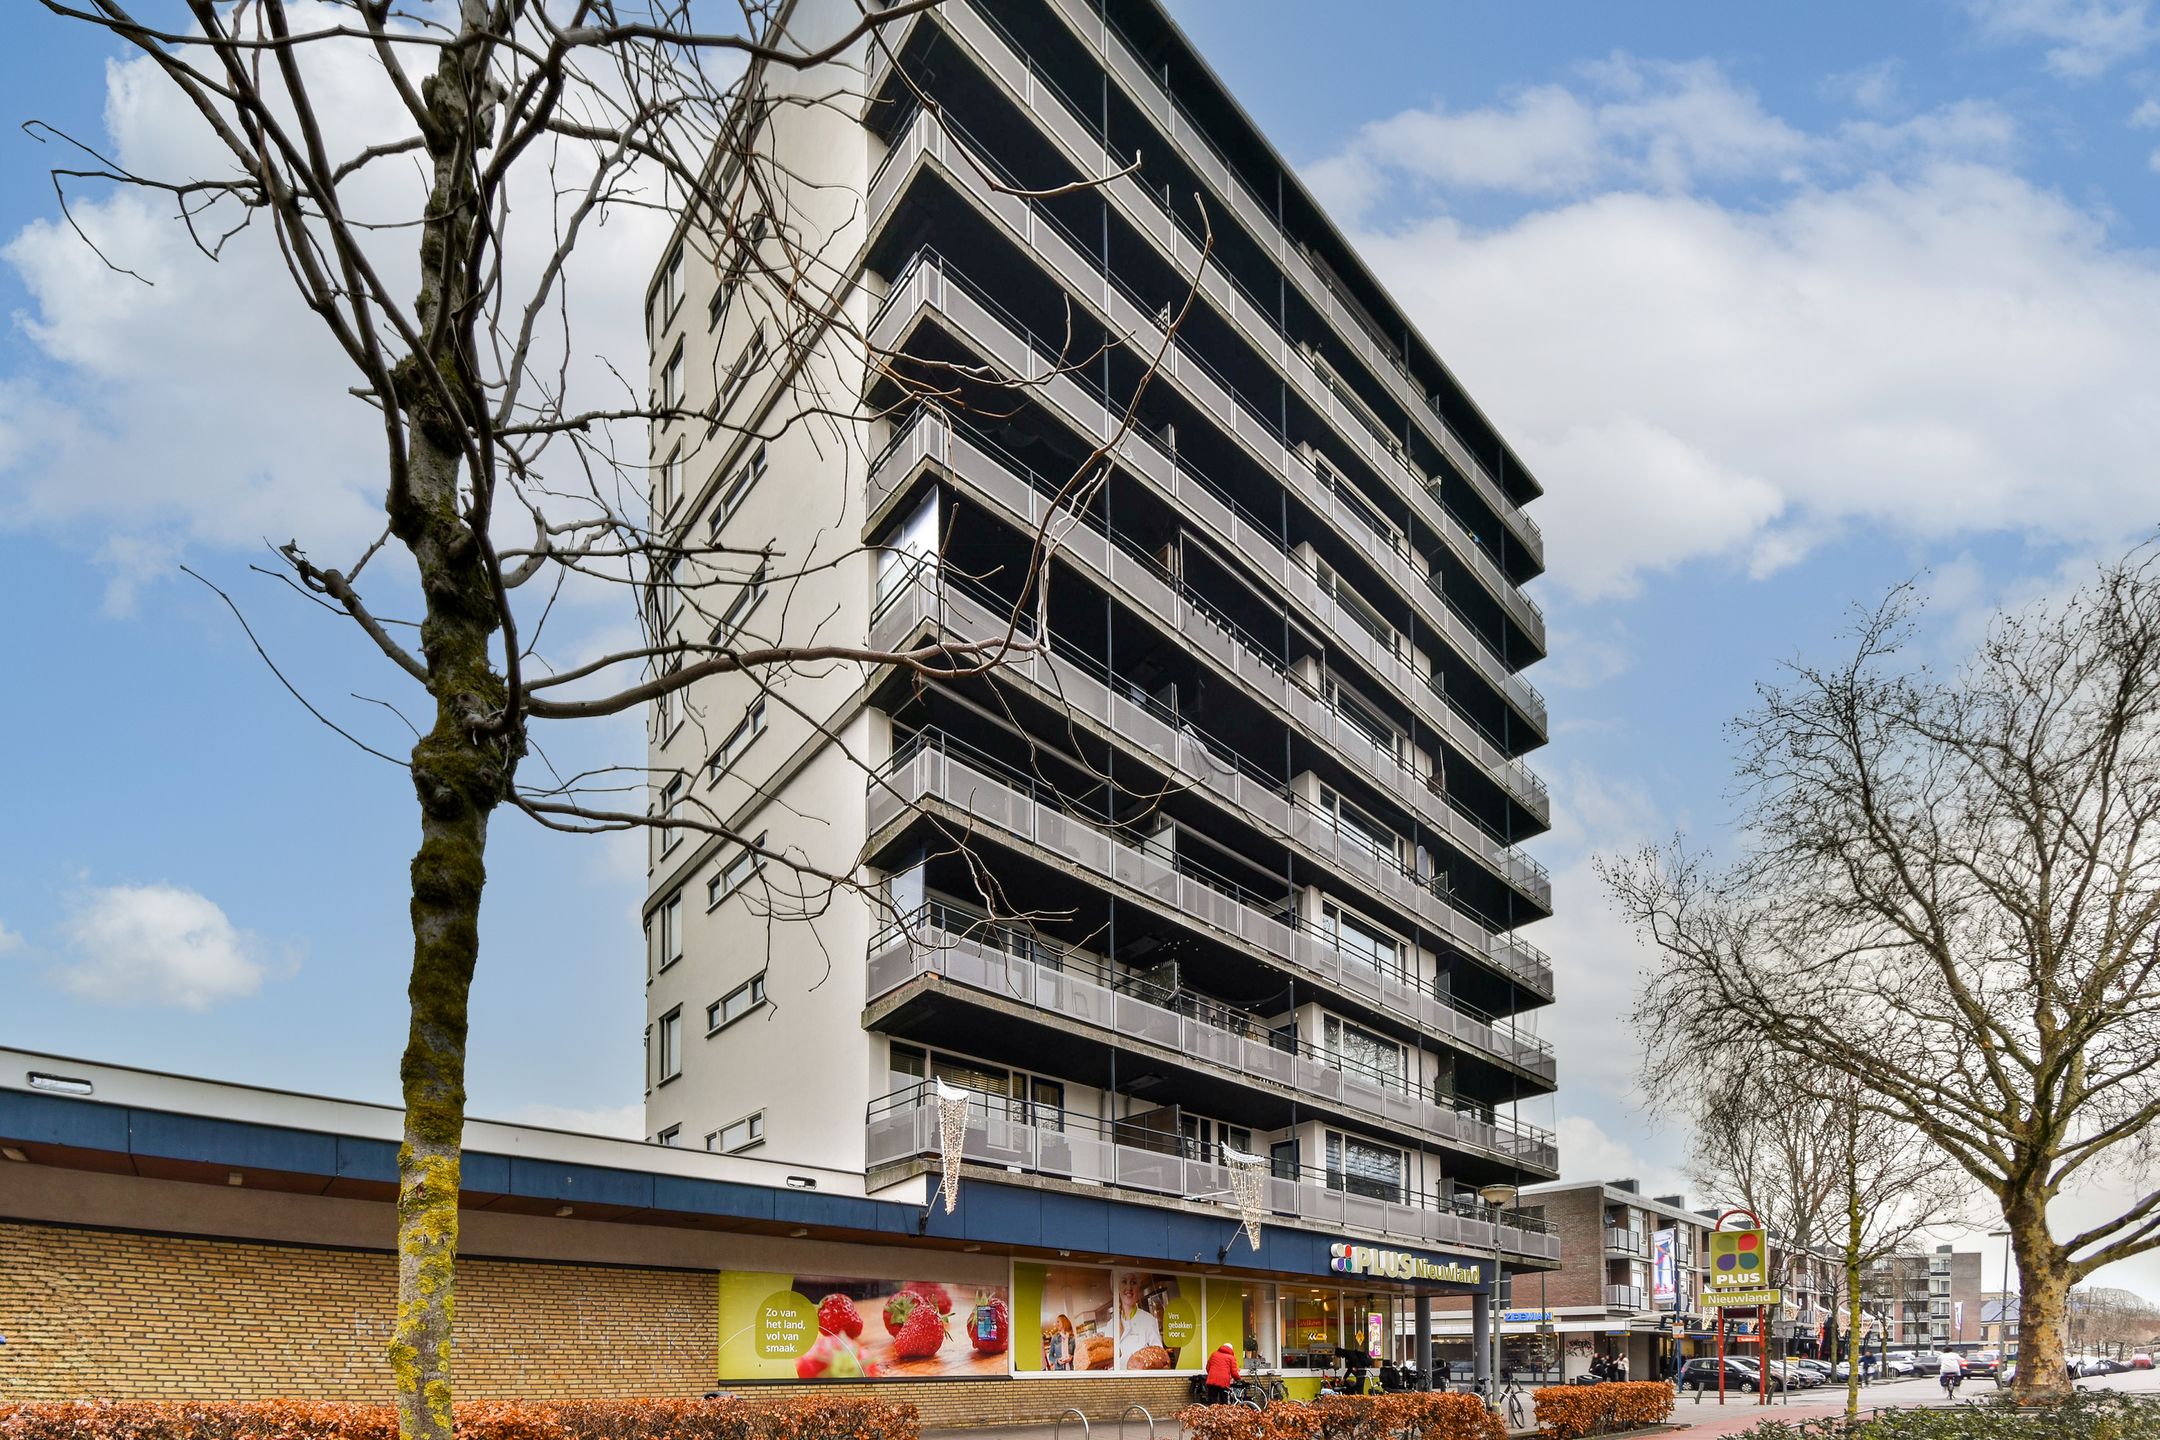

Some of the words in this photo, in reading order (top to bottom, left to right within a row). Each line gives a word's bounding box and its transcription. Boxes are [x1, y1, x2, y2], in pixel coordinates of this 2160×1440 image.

[1352, 1246, 1412, 1279] PLUS
[1414, 1258, 1480, 1284] Nieuwland
[1716, 1272, 1760, 1285] PLUS
[1707, 1292, 1771, 1304] Nieuwland
[766, 1307, 778, 1317] Zo
[1168, 1312, 1180, 1320] Vers
[1504, 1311, 1553, 1322] ZEEMAN
[766, 1319, 782, 1329] het
[783, 1319, 806, 1330] land,
[1168, 1321, 1193, 1331] gebakken
[766, 1331, 780, 1341] vol
[782, 1333, 799, 1341] van
[766, 1343, 798, 1353] smaak.
